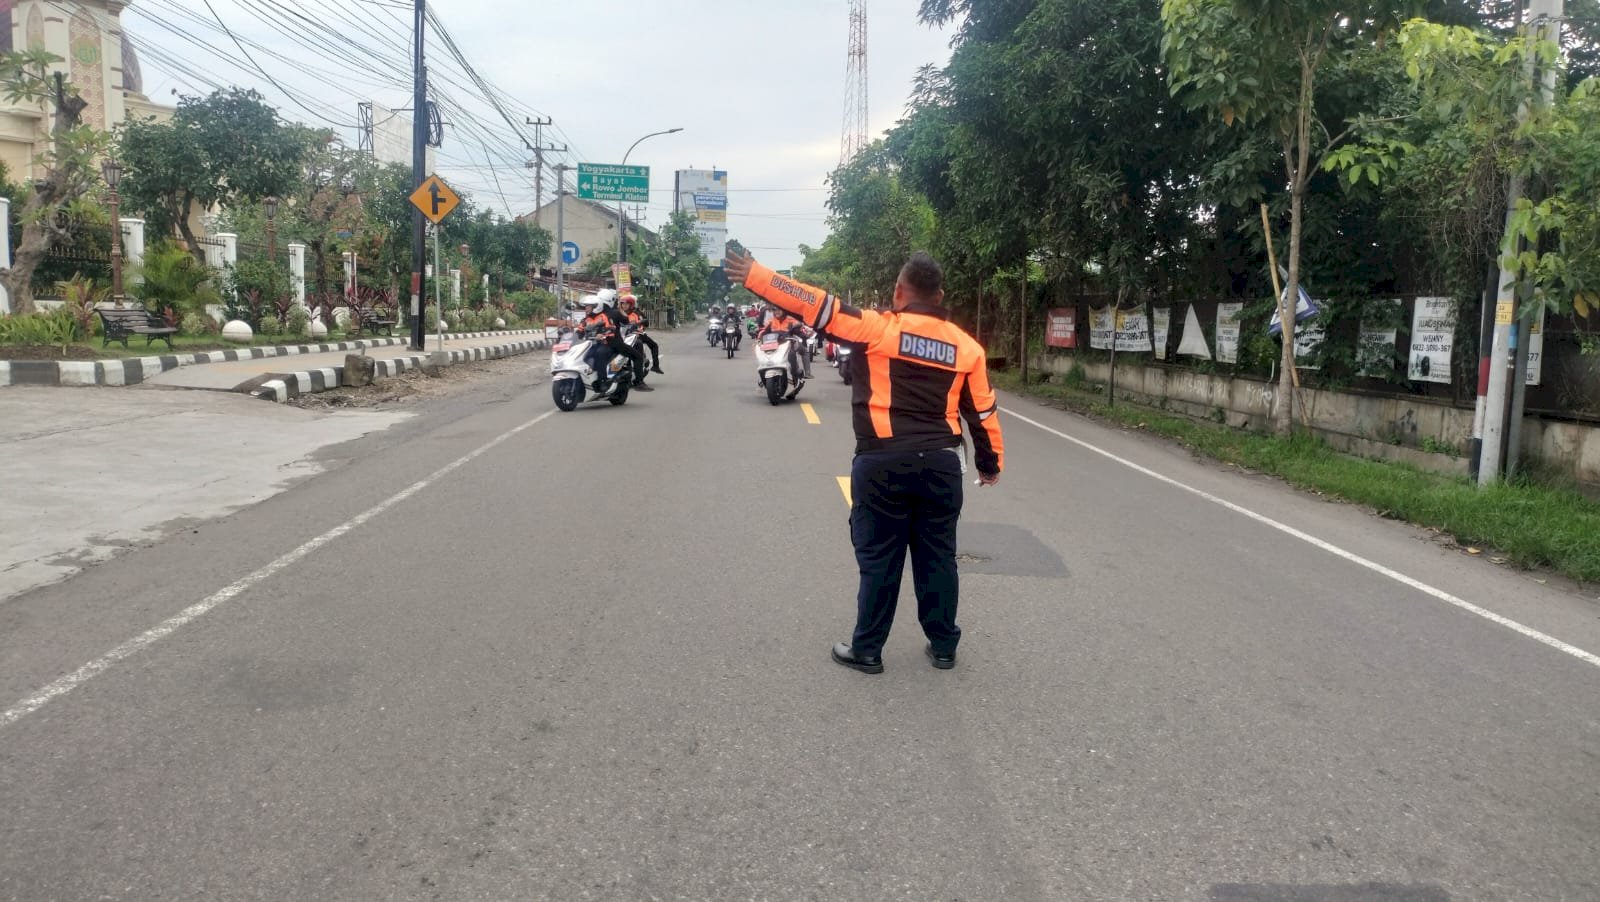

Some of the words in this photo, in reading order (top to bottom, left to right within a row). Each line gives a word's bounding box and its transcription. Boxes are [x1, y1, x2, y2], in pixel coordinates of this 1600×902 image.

[581, 165, 636, 175] Yogyakarta
[593, 184, 616, 192] Rowo
[618, 185, 649, 194] Jombor
[592, 192, 623, 200] Terminal
[625, 194, 649, 202] Klaten
[771, 276, 816, 305] DISHUB
[901, 334, 955, 364] DISHUB
